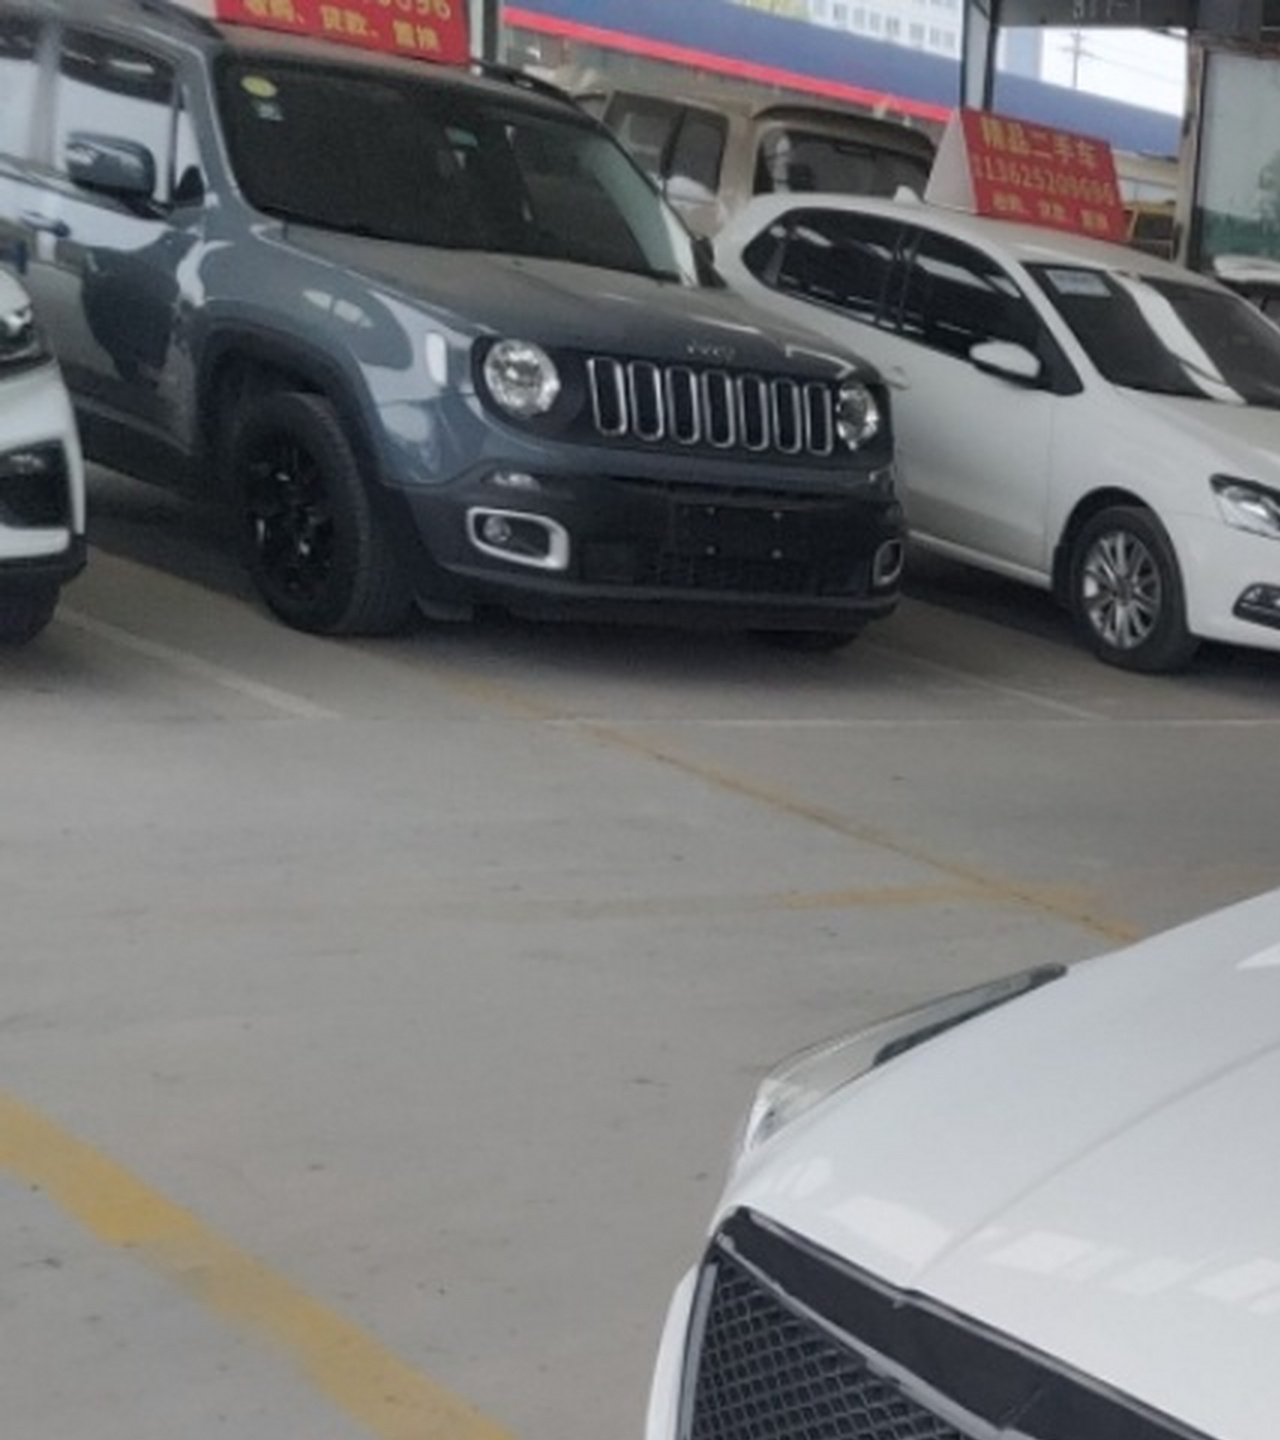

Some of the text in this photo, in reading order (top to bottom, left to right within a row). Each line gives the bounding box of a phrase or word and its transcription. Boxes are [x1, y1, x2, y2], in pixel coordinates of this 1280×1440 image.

[980, 115, 1097, 170] 精品二手车
